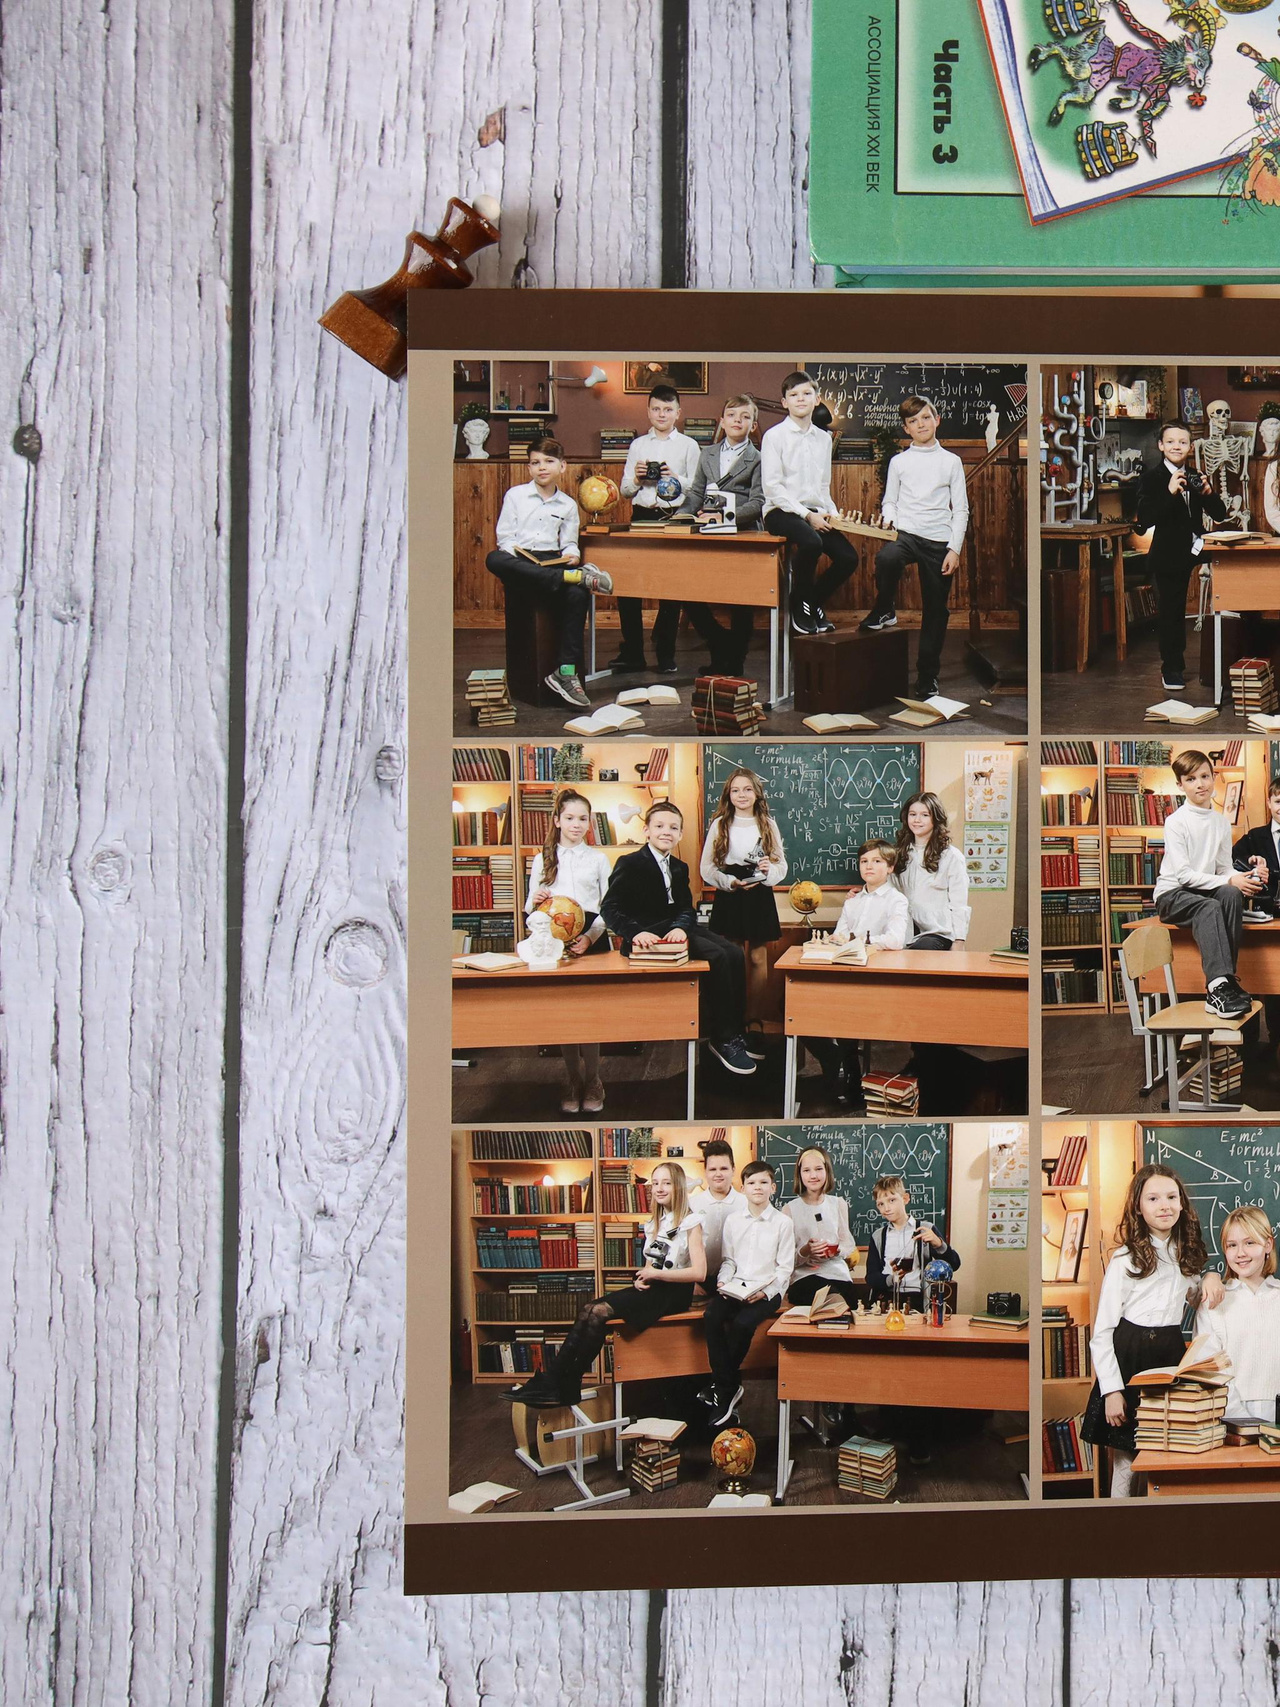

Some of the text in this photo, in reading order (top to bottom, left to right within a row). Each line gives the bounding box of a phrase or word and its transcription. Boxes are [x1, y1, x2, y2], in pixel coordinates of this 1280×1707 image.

[865, 15, 882, 193] АССОЦИАЦИЯ XXI ВЕК
[932, 39, 959, 165] Часть 3
[760, 754, 803, 765] formula
[807, 1131, 845, 1140] formula
